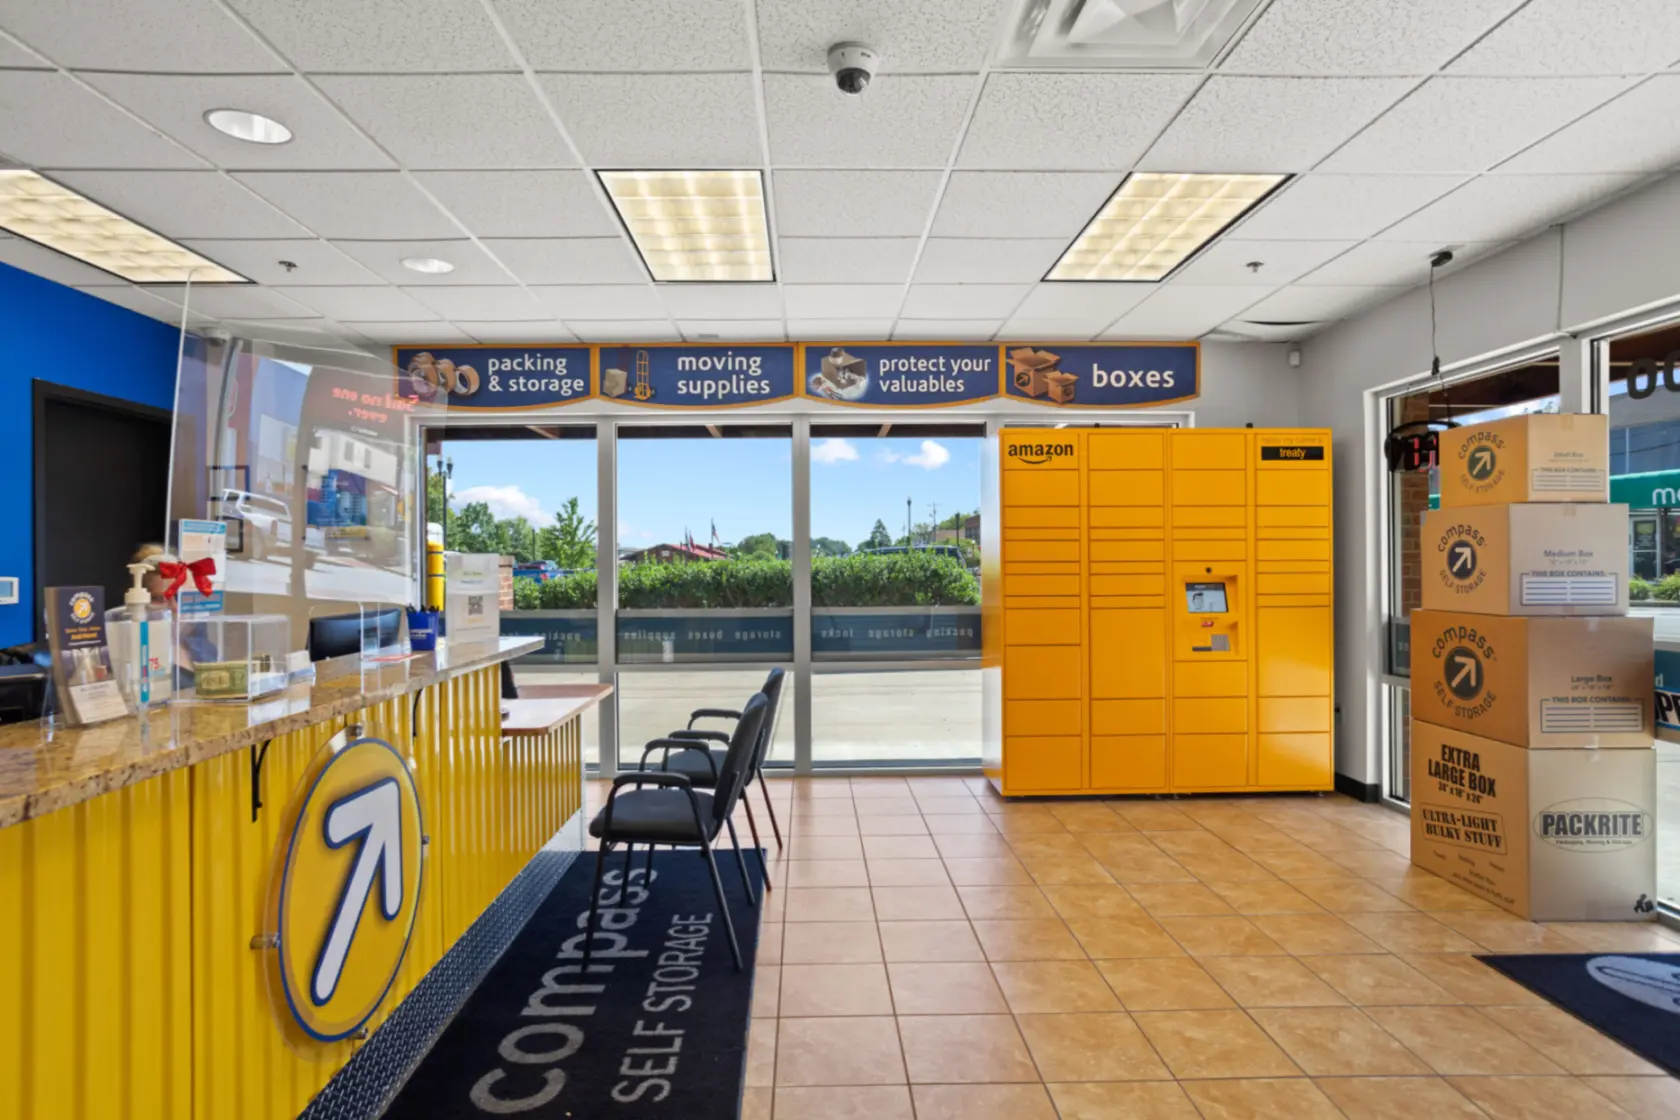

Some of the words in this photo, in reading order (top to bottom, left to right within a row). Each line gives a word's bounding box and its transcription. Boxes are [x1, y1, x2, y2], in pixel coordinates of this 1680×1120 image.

[488, 353, 567, 376] packing
[678, 352, 762, 375] moving
[879, 356, 946, 376] protect
[951, 357, 991, 376] your
[1093, 363, 1175, 388] boxes
[488, 376, 503, 391] &
[508, 375, 584, 395] storage
[677, 375, 770, 399] supplies
[879, 375, 964, 393] valuables
[1008, 443, 1074, 458] amazon
[1458, 431, 1503, 459] compass
[1438, 524, 1484, 552] compass
[1456, 571, 1487, 594] STORAGE
[1432, 626, 1494, 658] compass
[1434, 680, 1453, 709] SELF
[1454, 690, 1496, 719] STORAGE
[1441, 744, 1480, 772] EXTRA
[1428, 758, 1465, 787] LARGE
[1469, 771, 1496, 797] BOX
[1422, 808, 1498, 832] ULTRA-LIGHT
[1542, 813, 1642, 837] PACKRITE
[1426, 823, 1460, 841] BULKY
[1464, 830, 1502, 848] STUFF
[642, 913, 713, 1013] STORAGE
[469, 867, 658, 1114] compass
[611, 1020, 686, 1103] SELF
